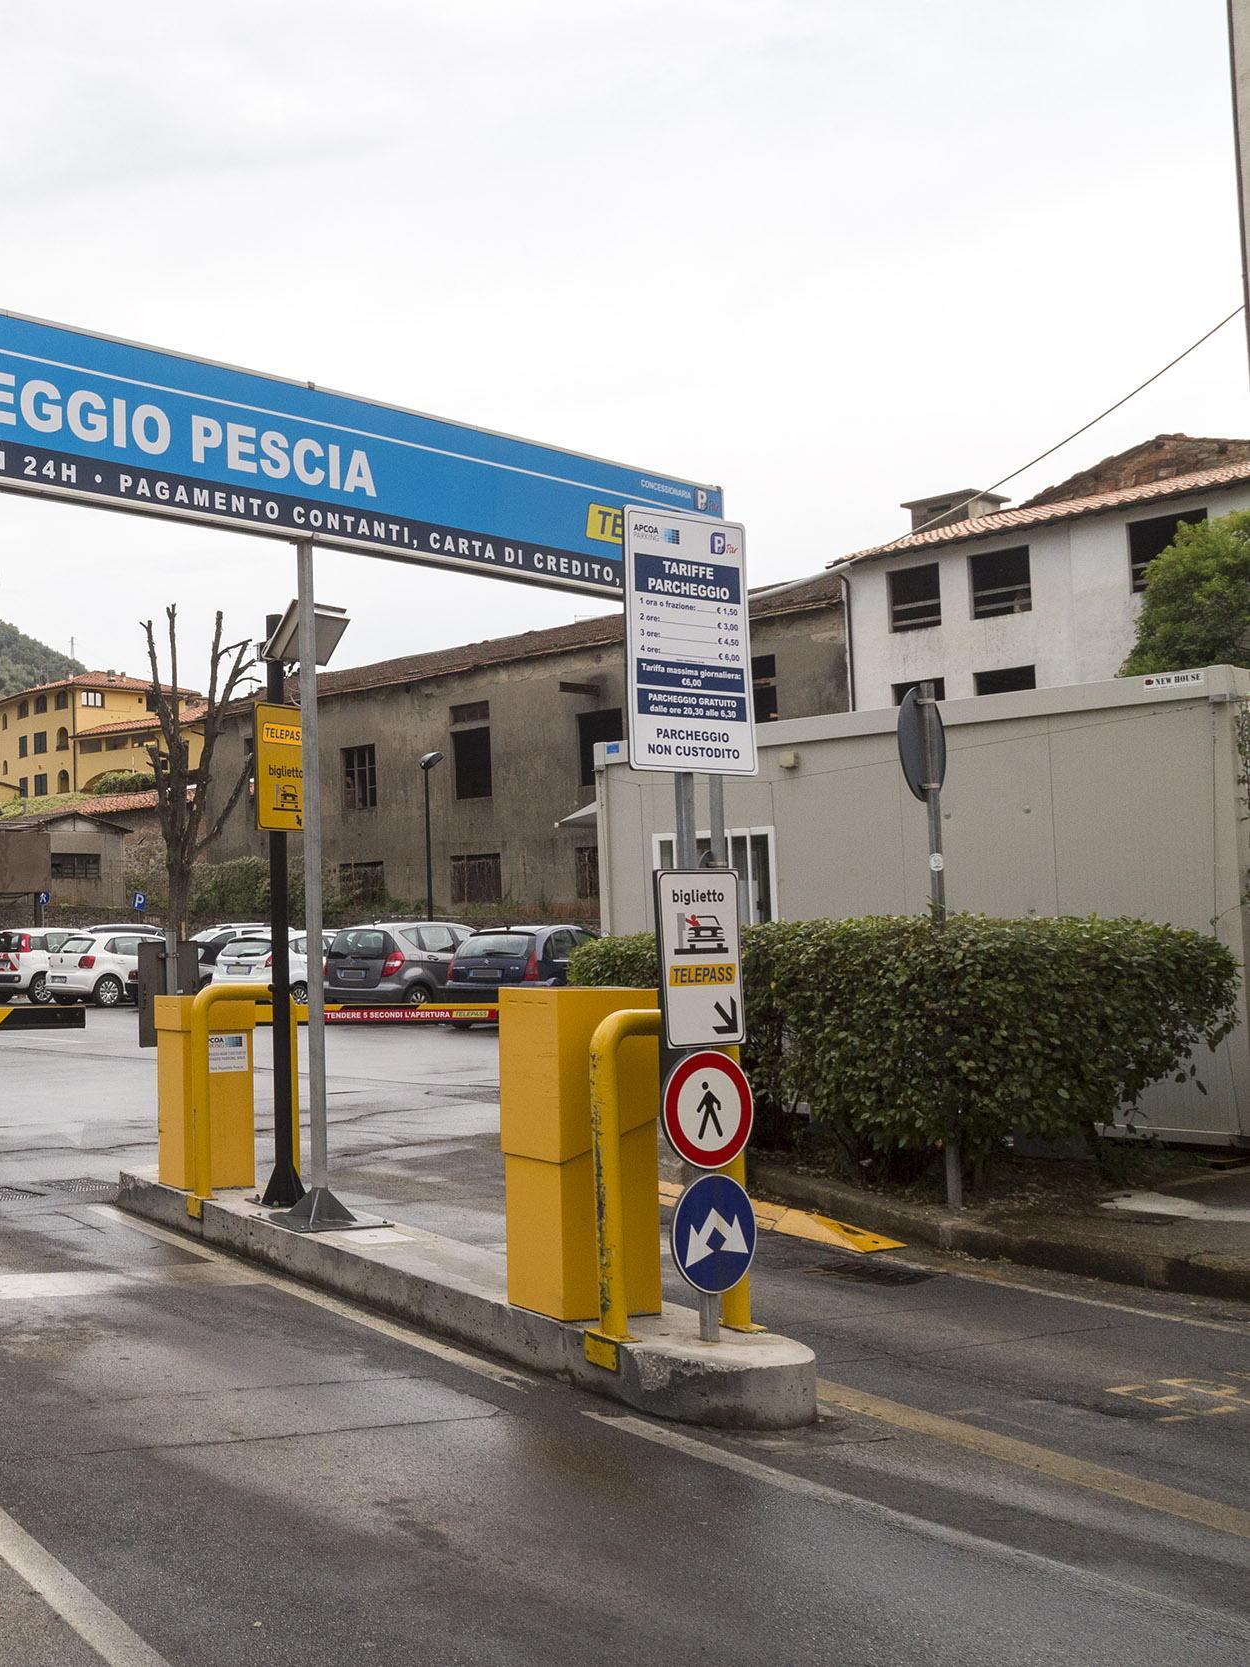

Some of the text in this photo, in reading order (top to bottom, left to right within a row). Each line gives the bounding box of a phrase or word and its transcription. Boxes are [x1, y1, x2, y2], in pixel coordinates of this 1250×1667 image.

[191, 414, 377, 498] PESCIA
[23, 455, 78, 484] 24H
[119, 474, 280, 521] PAGAMENTO
[292, 506, 418, 549] CONTANTI,
[429, 532, 496, 561] CARTA
[504, 547, 524, 566] DI
[533, 554, 621, 587] CREDITO,
[597, 510, 623, 538] TE
[633, 523, 659, 535] APCOA
[662, 560, 714, 580] TARIFFE
[647, 577, 730, 600] PARCHEGGIO
[665, 600, 696, 611] frazione:
[723, 608, 738, 616] 1,50
[724, 623, 738, 631] 3,00
[724, 638, 739, 647] 4,50
[647, 646, 661, 654] ore:
[724, 653, 740, 662] 6,00
[641, 663, 742, 680] Tariffa massima giornaliera:
[1174, 673, 1201, 683] HOUSE
[681, 678, 702, 688] €6,00
[648, 693, 737, 708] PARCHEGGIO GRATUITO
[649, 704, 737, 719] dalle ore 20,30 alle 6,30
[265, 727, 303, 741] TELEPAS
[656, 728, 730, 743] PARCHEGGIO
[647, 743, 740, 760] NON CUSTODITO
[135, 894, 144, 907] P
[672, 889, 725, 906] biglietto
[673, 965, 733, 984] TELEPASS
[324, 1011, 362, 1019] TENDERE
[369, 1011, 403, 1019] SECONDI
[405, 1010, 450, 1018] L'APERTURA
[455, 1010, 488, 1018] TELEPASS
